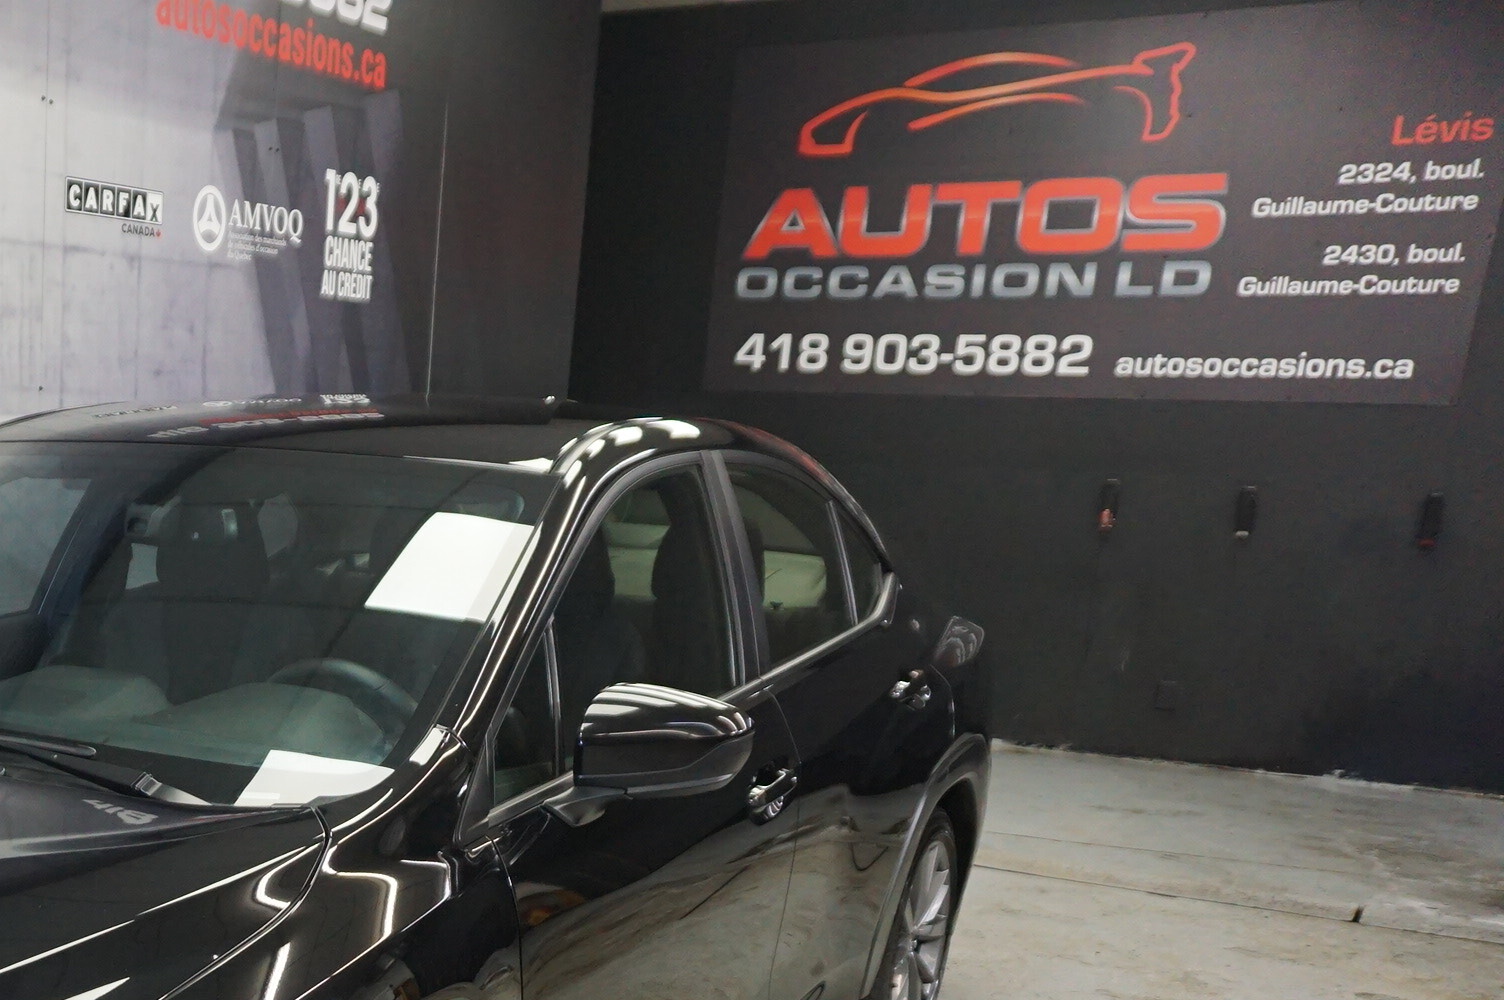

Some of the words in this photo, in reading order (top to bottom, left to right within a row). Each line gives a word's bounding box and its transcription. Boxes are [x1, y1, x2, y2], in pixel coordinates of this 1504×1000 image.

[155, 0, 387, 89] autosoccasions.ca
[1391, 113, 1494, 147] Lévis
[1337, 161, 1417, 185] 2324,
[1424, 157, 1485, 181] boul.
[68, 183, 160, 222] CARFAX
[743, 172, 1228, 260] AUTOS
[1251, 192, 1479, 219] Guillaume-Couture
[121, 223, 156, 237] CANADA
[228, 199, 304, 243] AMVOQ
[324, 235, 373, 271] CHANCE
[1321, 243, 1400, 267] 2430,
[1407, 242, 1466, 264] boul.
[321, 270, 337, 296] AU
[338, 270, 373, 299] CRÉDIT
[735, 261, 1098, 299] OCCASION
[1114, 259, 1213, 298] LD
[1236, 274, 1461, 298] Guillaume-Couture
[734, 333, 830, 373] 418
[841, 333, 1094, 377] 903-5882
[1113, 351, 1415, 380] autosoccasions.ca
